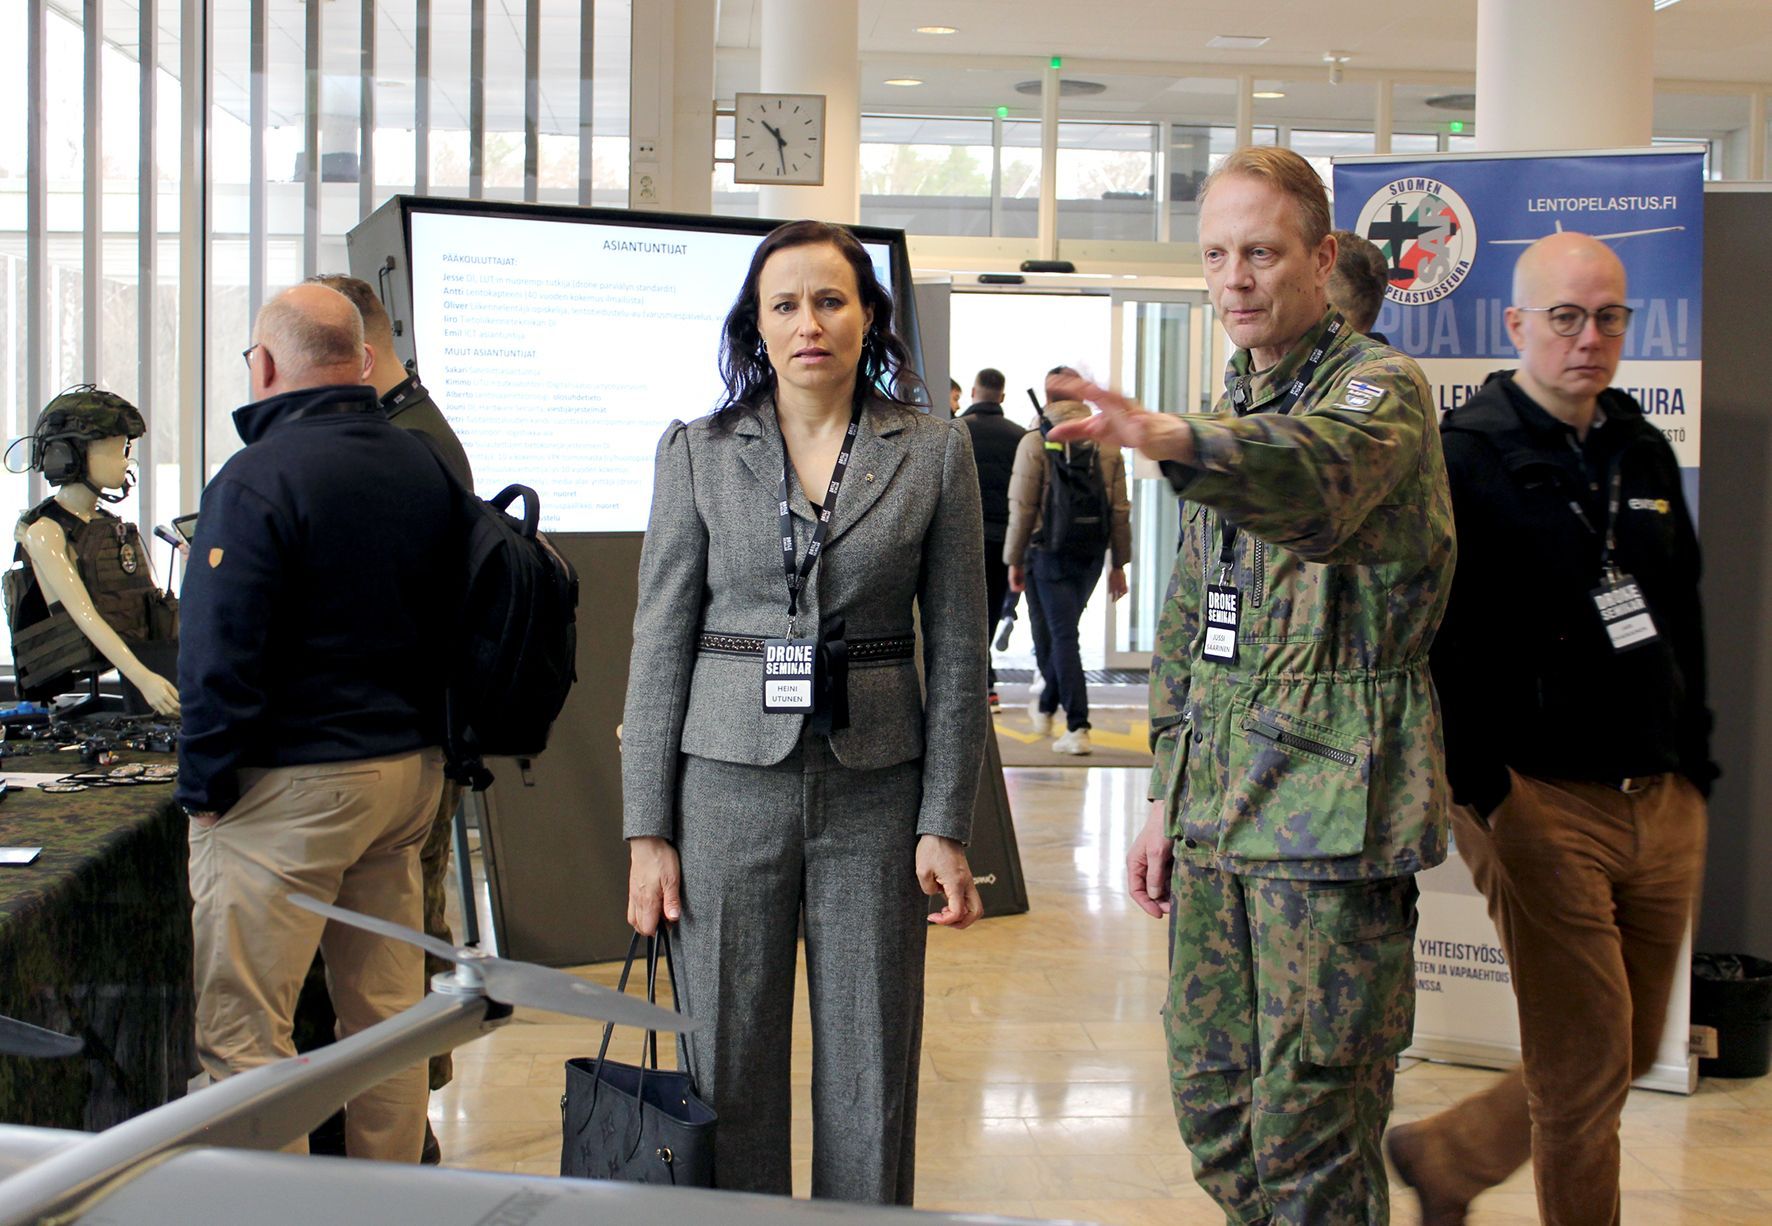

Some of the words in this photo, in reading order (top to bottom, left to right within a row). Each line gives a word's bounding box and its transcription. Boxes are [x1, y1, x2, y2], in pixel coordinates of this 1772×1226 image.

[1389, 179, 1442, 196] SUOMEN
[1528, 196, 1677, 212] LENTOPELASTUS.FI
[603, 240, 688, 255] ASIANTUNTIJAT
[443, 273, 464, 282] Jesse
[443, 301, 468, 310] Oliver
[444, 347, 470, 356] MUUT
[1208, 591, 1237, 611] DRONE
[1208, 609, 1236, 625] SEMINAR
[766, 645, 812, 662] DRONE
[766, 662, 812, 675] SEMINAR
[772, 695, 803, 703] UTUNEN
[1418, 939, 1508, 966] YHTEISTYÖSS
